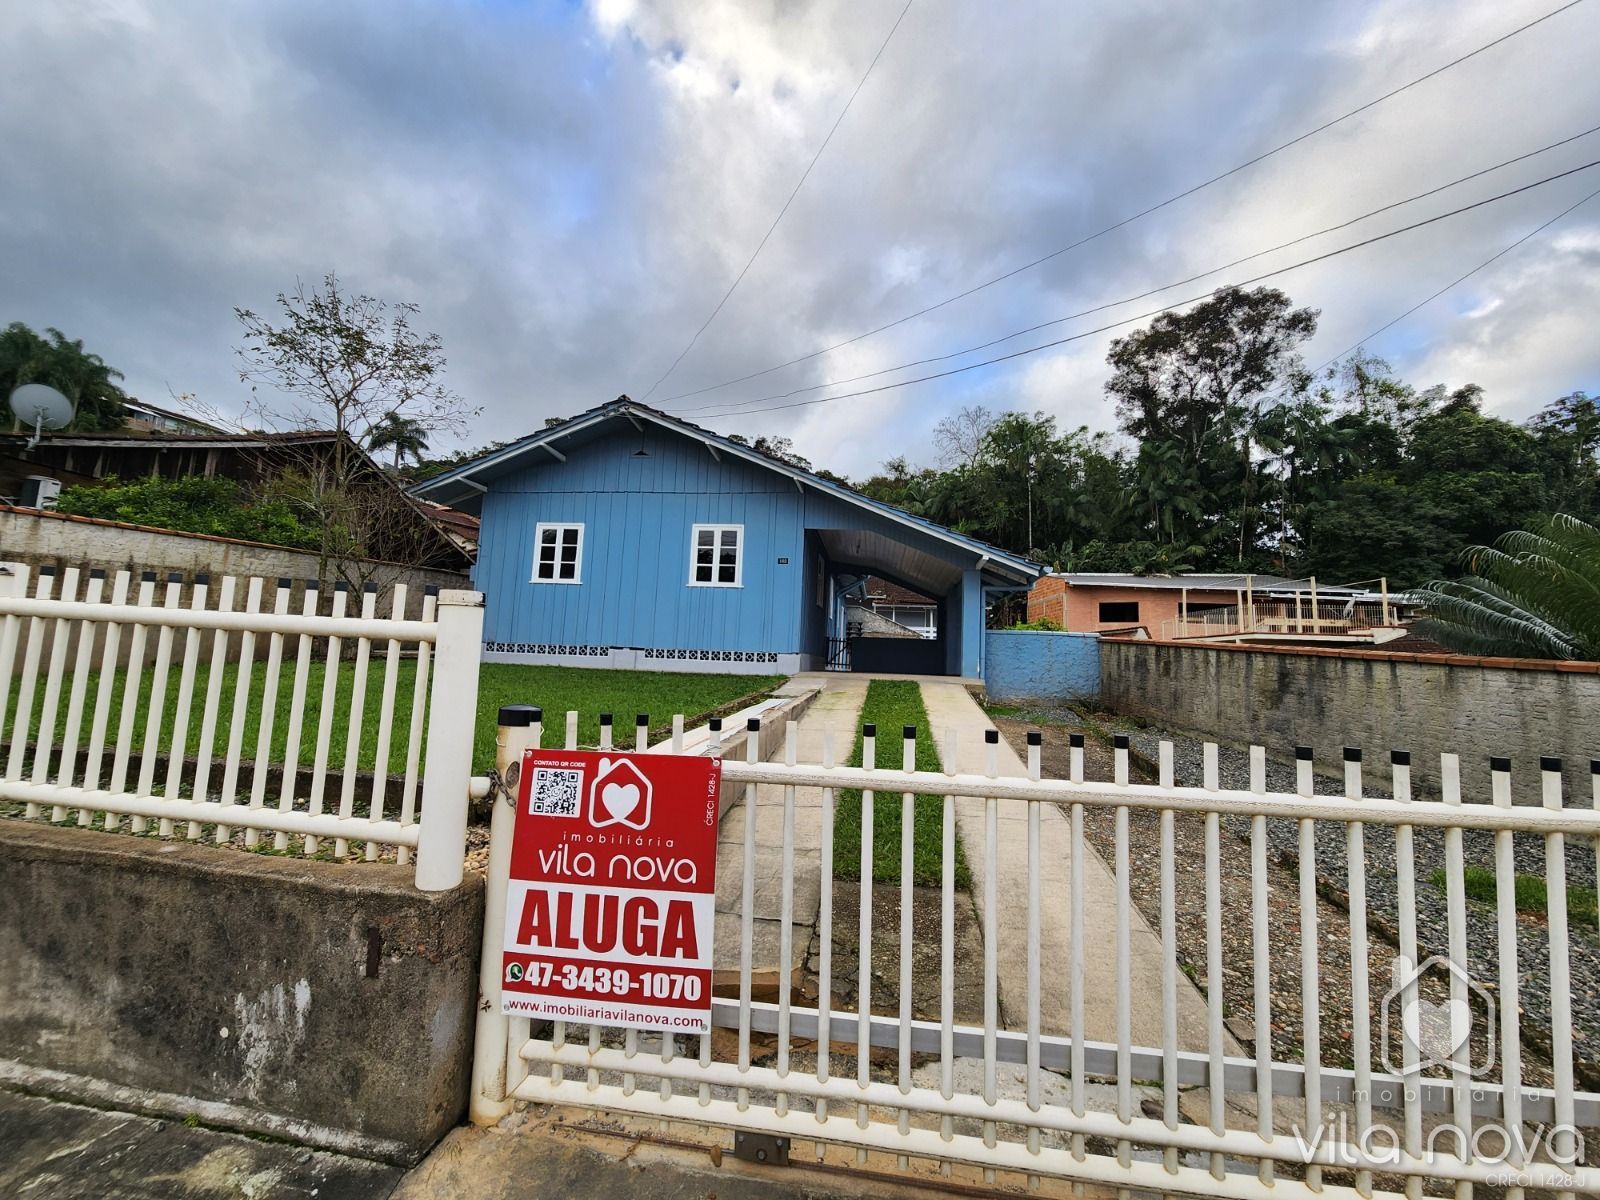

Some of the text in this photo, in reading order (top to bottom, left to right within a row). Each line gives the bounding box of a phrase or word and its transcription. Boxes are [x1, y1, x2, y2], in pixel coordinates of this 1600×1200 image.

[706, 773, 716, 826] CRECI 1428-J
[563, 831, 674, 848] imobiliária
[538, 844, 697, 884] vila nova
[516, 889, 699, 959] ALUGA
[524, 961, 701, 1001] 47-3439-1070
[509, 1000, 703, 1027] www.imobiliariavilanova.com
